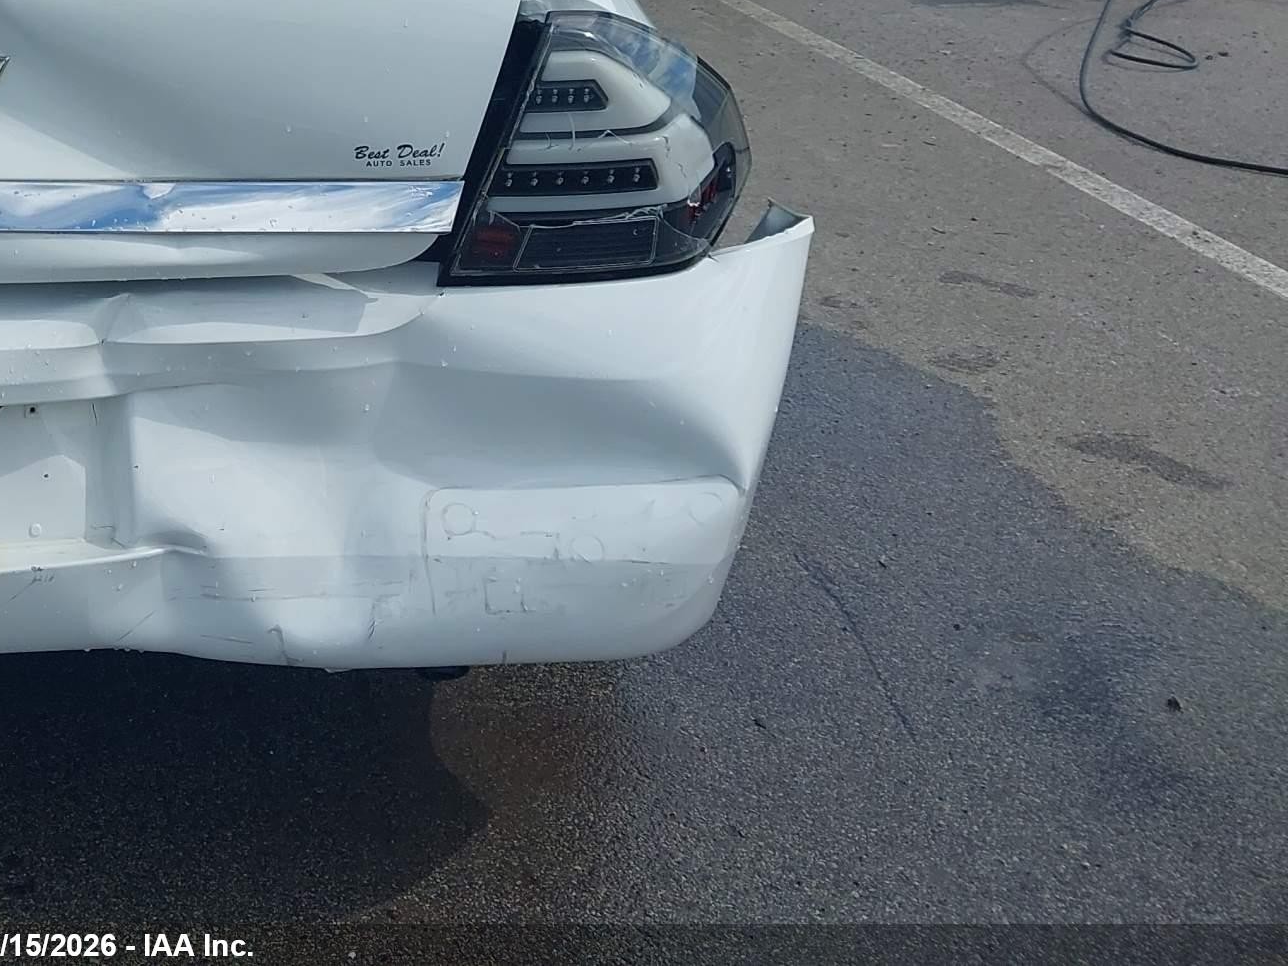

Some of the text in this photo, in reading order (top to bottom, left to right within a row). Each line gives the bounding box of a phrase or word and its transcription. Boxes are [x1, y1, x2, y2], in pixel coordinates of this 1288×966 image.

[353, 142, 445, 160] Best Deal!
[399, 159, 431, 167] SALES
